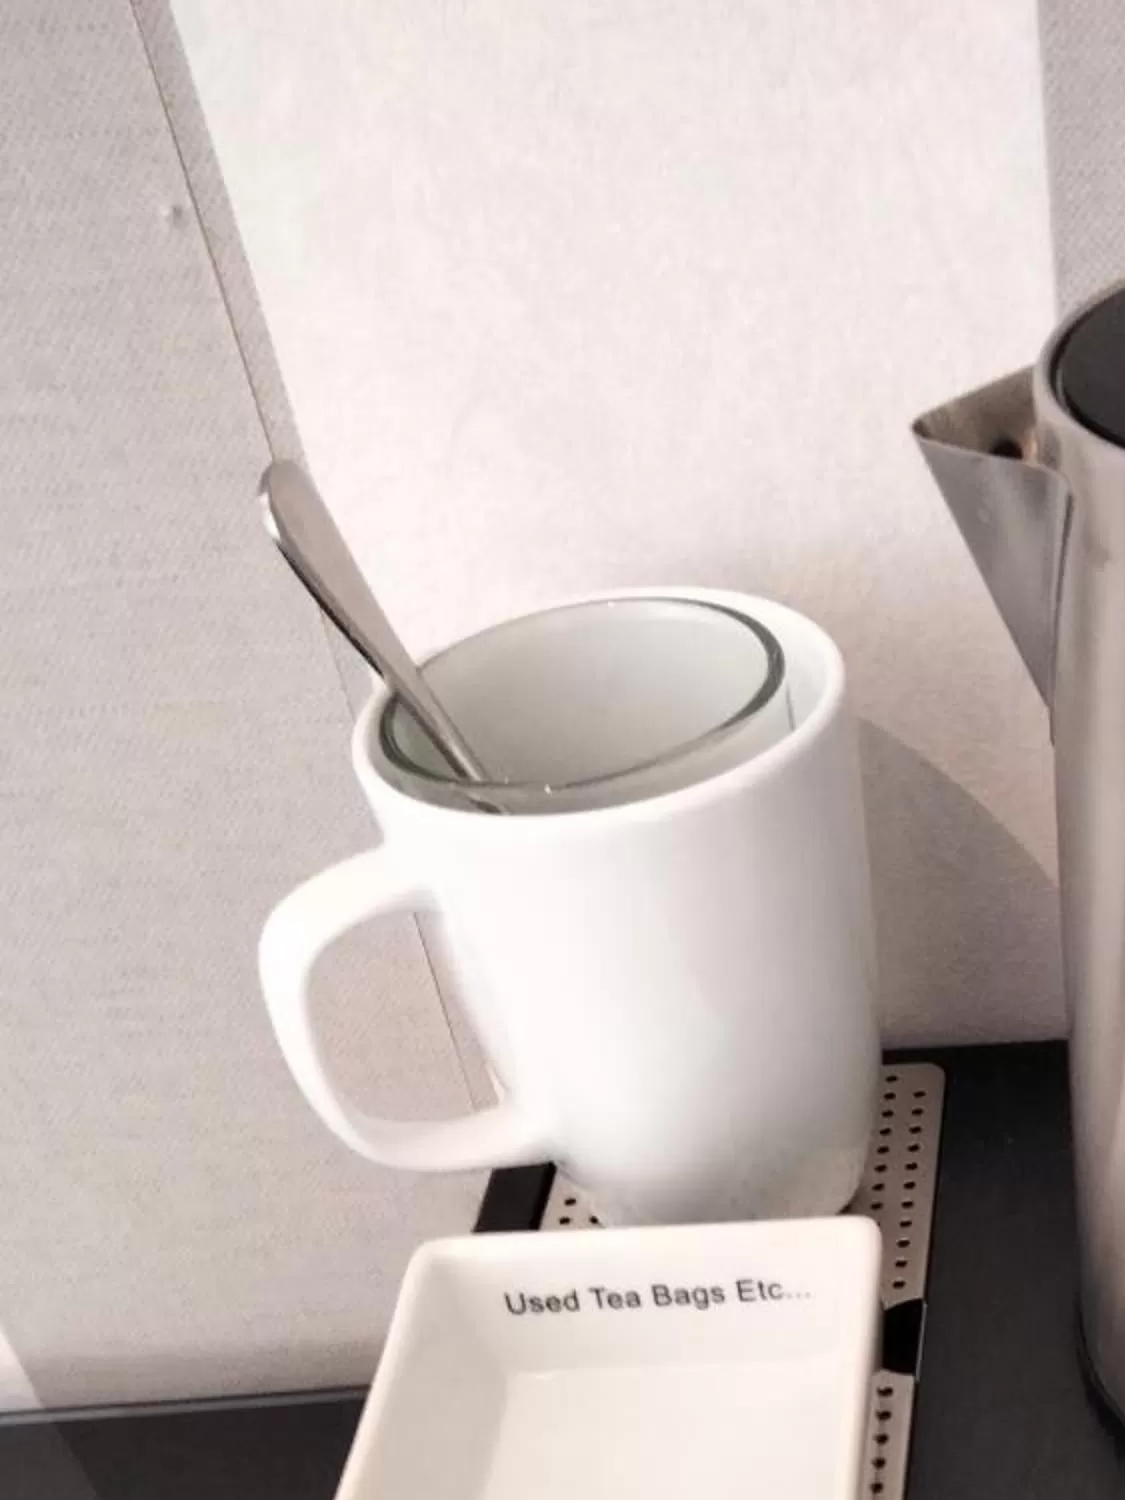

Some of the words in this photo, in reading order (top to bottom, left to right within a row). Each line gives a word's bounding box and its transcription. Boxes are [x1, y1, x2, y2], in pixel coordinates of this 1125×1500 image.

[503, 1289, 581, 1316] Used
[588, 1285, 642, 1310] Tea
[650, 1283, 726, 1311] Bags
